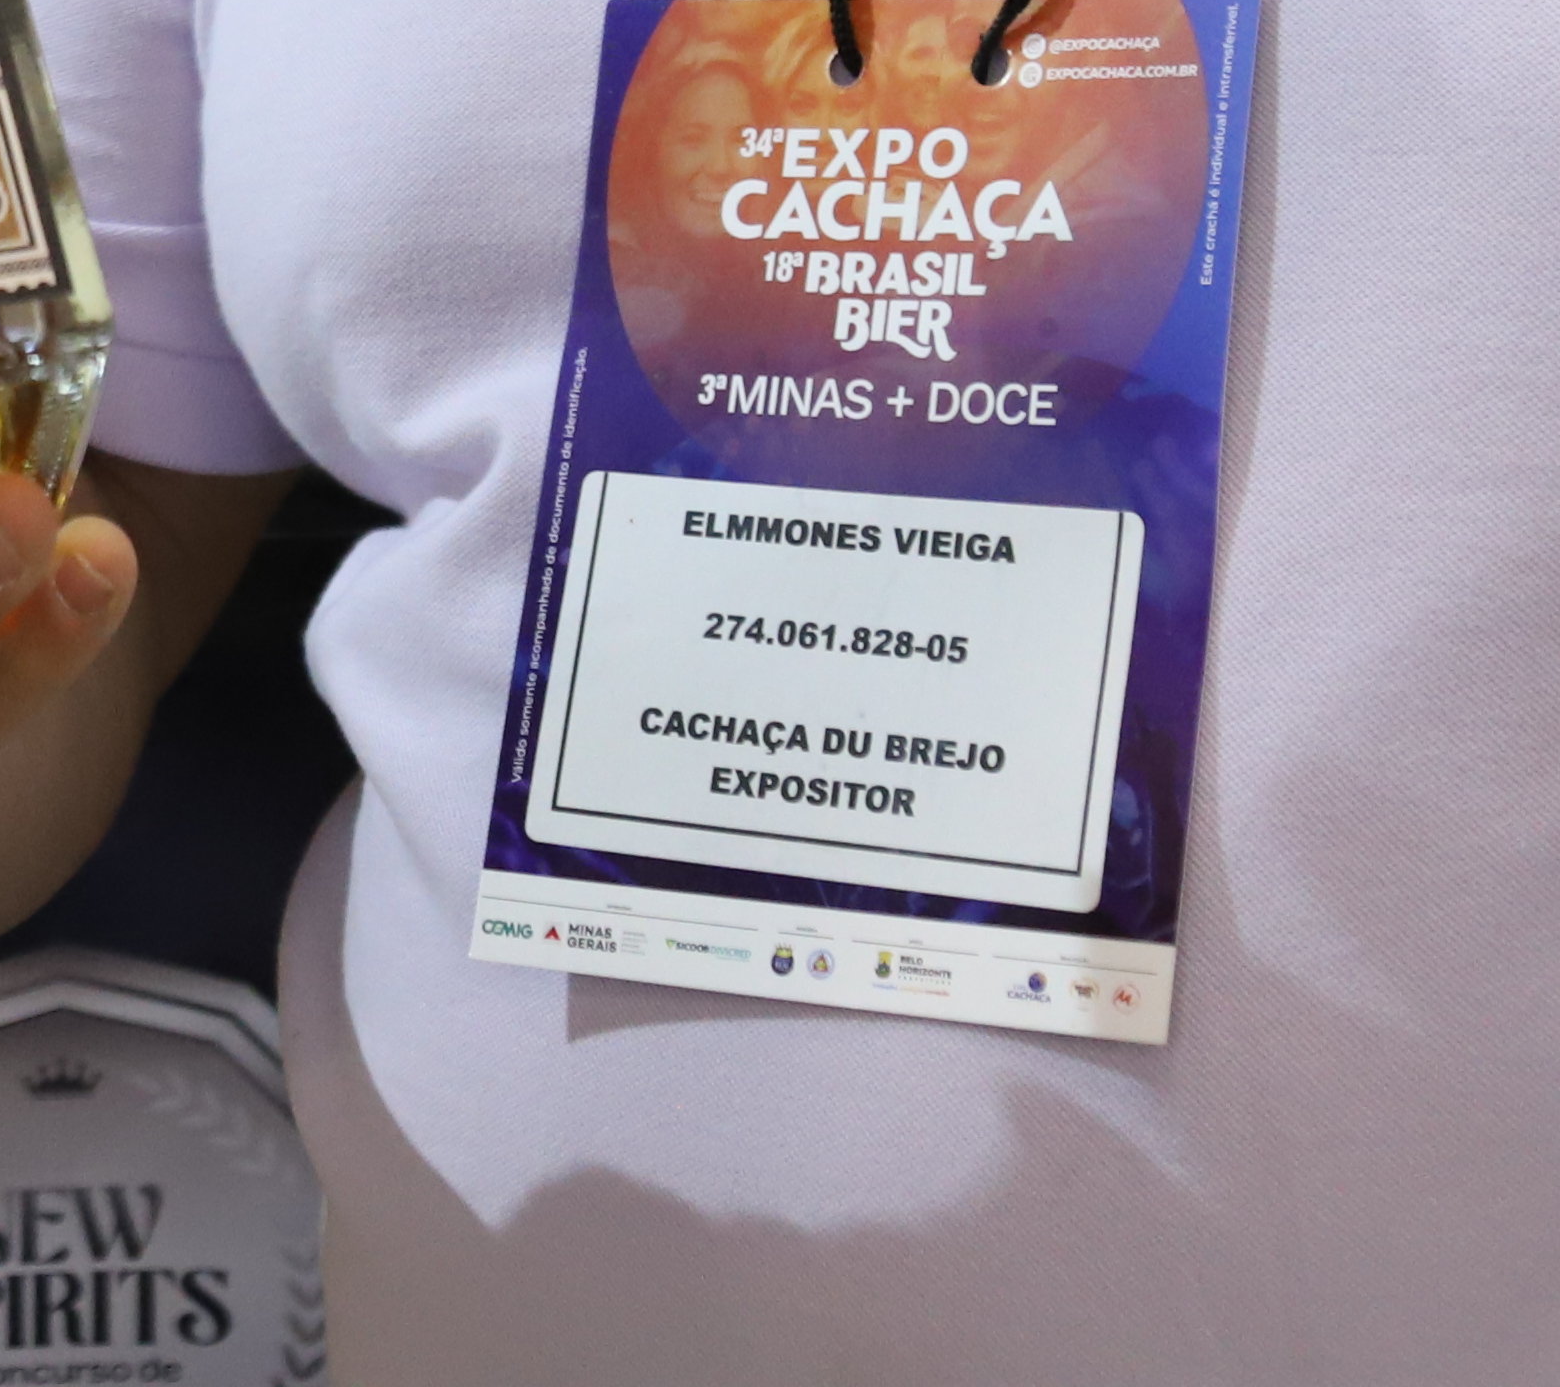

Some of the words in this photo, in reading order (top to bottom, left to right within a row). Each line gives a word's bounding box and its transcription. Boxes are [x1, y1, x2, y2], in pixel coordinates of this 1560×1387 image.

[1049, 37, 1160, 55] @EXPOCACHAÇA
[1217, 3, 1240, 99] intransferível.
[1046, 63, 1199, 82] EXPOCACHACA.COM.BR
[1219, 101, 1228, 112] e
[1209, 114, 1228, 186] individual
[1210, 186, 1220, 198] é
[721, 179, 1073, 259] CACHAÇA
[1204, 201, 1219, 251] crachá
[804, 251, 987, 297] BRASIL
[1200, 254, 1215, 286] Este
[833, 298, 957, 361] BIER
[564, 346, 589, 439] identificação.
[727, 375, 874, 420] MINAS
[886, 388, 914, 417] +
[927, 382, 1059, 426] DOCE
[561, 440, 572, 459] de
[549, 461, 570, 542] documento
[547, 544, 557, 564] de
[683, 510, 881, 552] ELMMONES
[894, 527, 1016, 564] VIEIGA
[529, 567, 554, 668] acompanhado
[703, 612, 969, 664] 274.061.828-05
[519, 671, 537, 735] somente
[511, 739, 528, 784] Válido
[640, 707, 810, 755] CACHAÇA
[822, 727, 873, 758] DU
[884, 734, 1006, 773] BREJO
[710, 766, 916, 817] EXPOSITOR
[566, 936, 618, 954] GERAIS
[567, 923, 613, 939] MINAS
[898, 964, 953, 980] HORIZONTE
[137, 1359, 183, 1385] de
